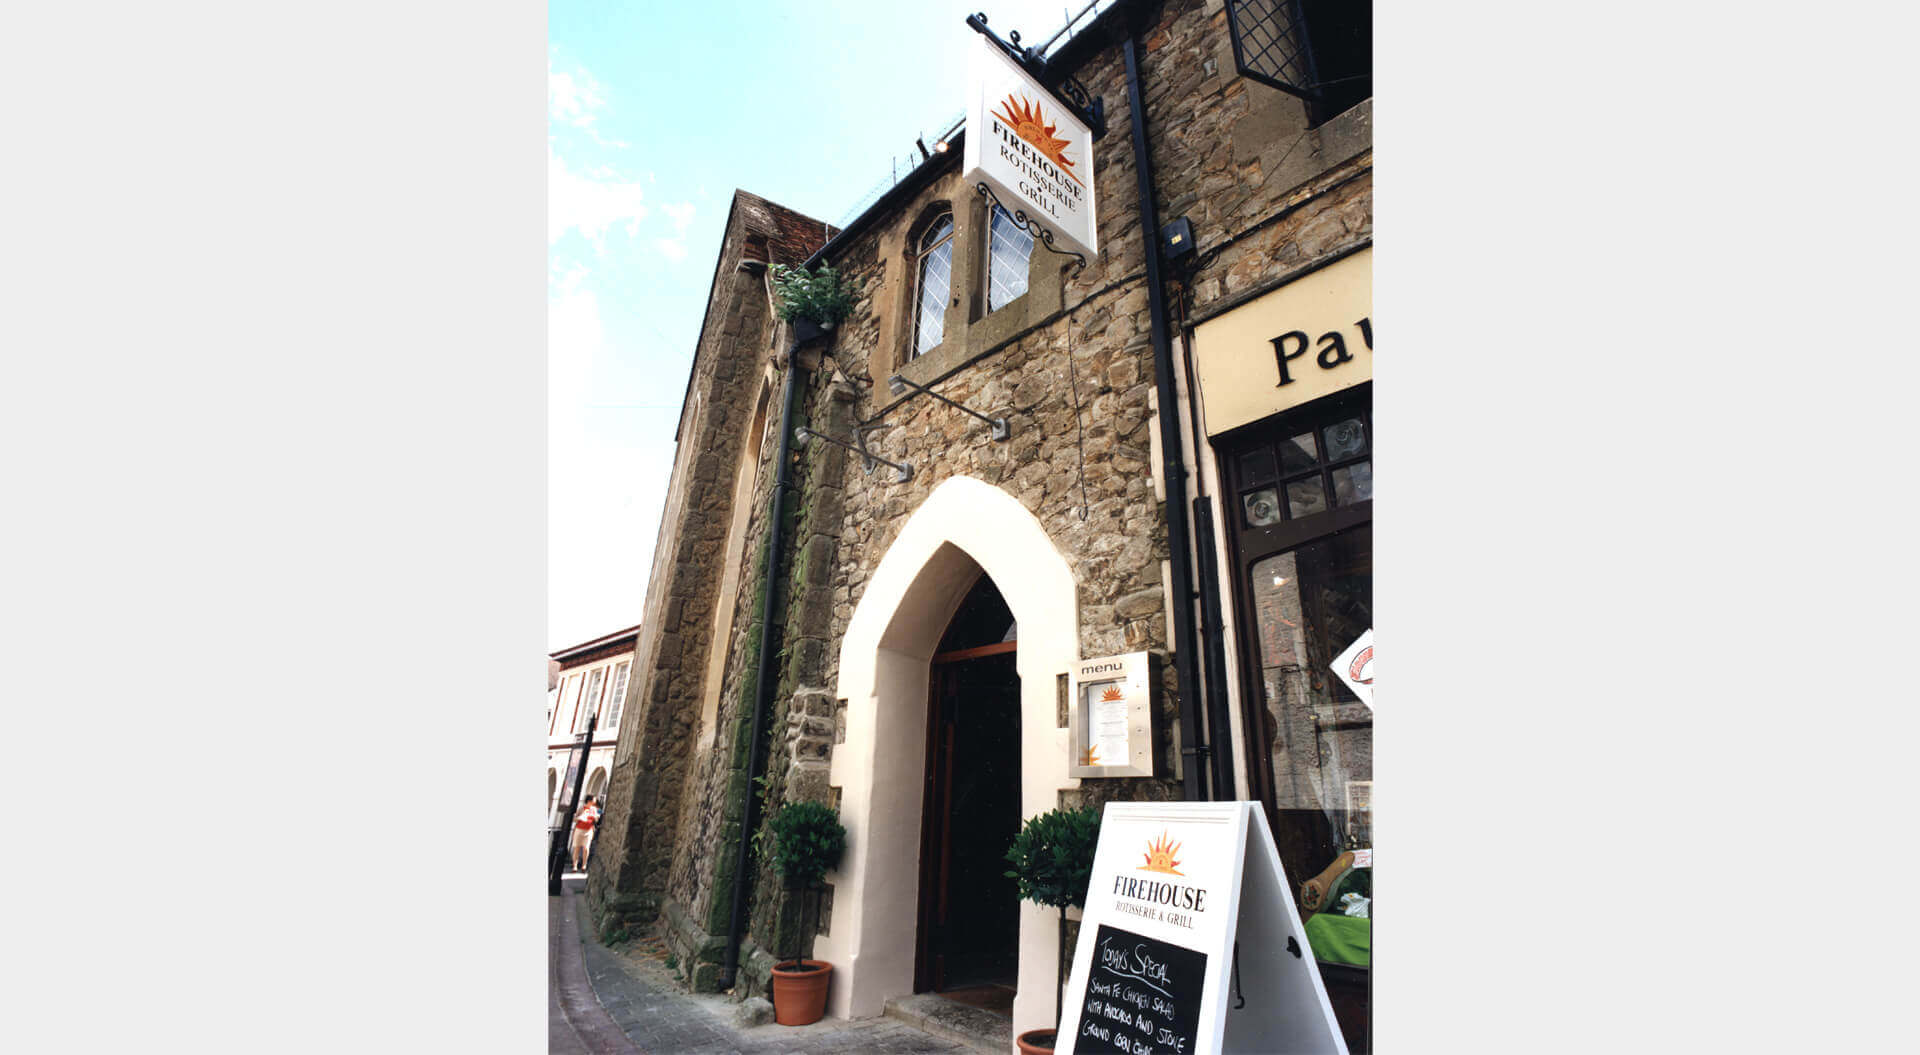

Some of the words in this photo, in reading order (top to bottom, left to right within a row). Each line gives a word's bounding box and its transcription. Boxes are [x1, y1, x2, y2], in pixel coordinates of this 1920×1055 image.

[993, 121, 1082, 201] FIREHOUSE
[1000, 145, 1076, 212] ROTISSERIE
[1019, 181, 1059, 219] GRILL
[1081, 662, 1123, 675] menu
[1113, 875, 1207, 912] FIREHOUSE
[1115, 902, 1156, 920] ROTISSERIE
[1167, 912, 1194, 929] GRILL
[1135, 1013, 1154, 1036] AND
